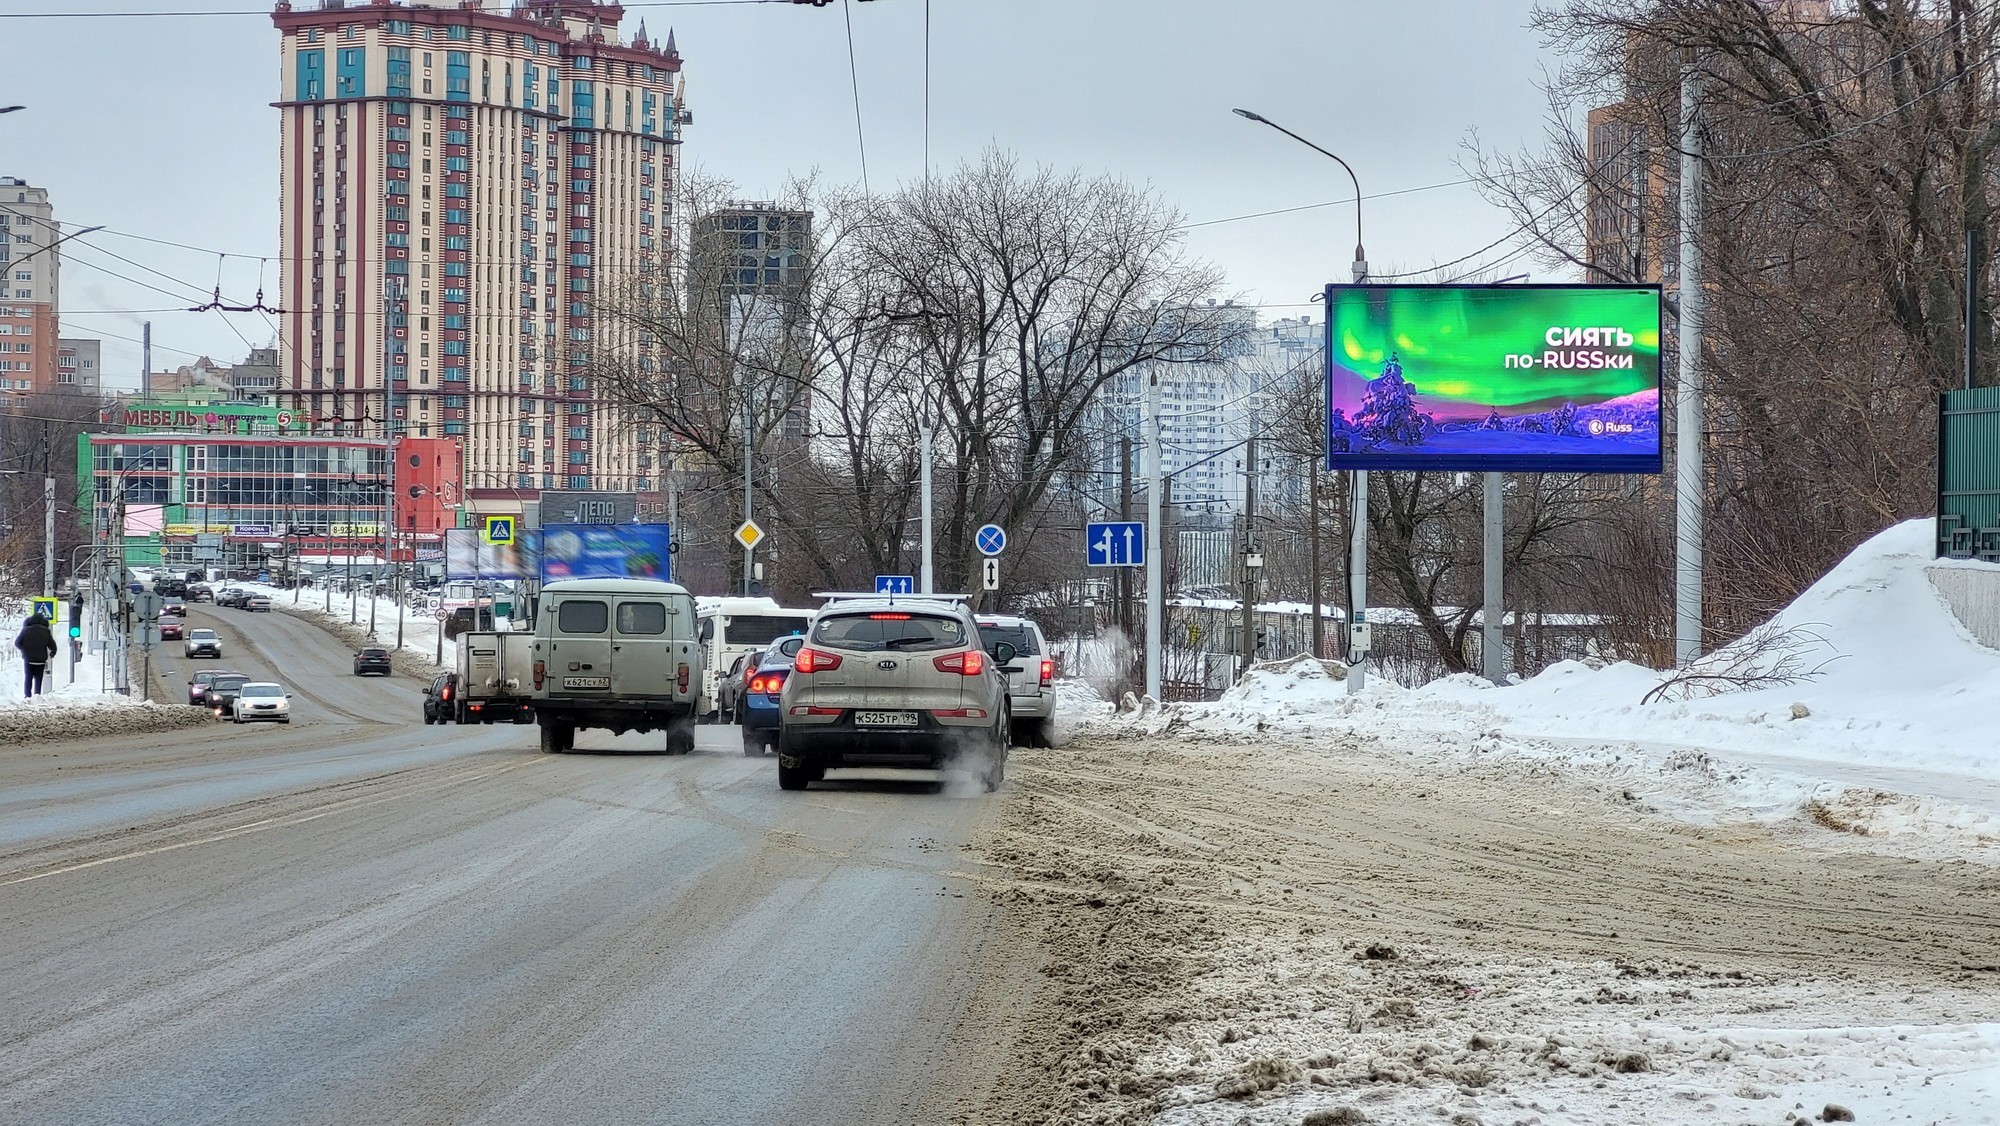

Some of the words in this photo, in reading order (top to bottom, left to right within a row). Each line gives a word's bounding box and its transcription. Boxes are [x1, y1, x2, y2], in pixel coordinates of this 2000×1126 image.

[1545, 327, 1633, 347] СИЯТЬ
[1504, 351, 1633, 369] по-RUSSки
[124, 410, 198, 426] МЕБЕЛЬ
[1605, 422, 1633, 432] Russ
[858, 713, 898, 724] К525ТР
[900, 713, 917, 723] 199
